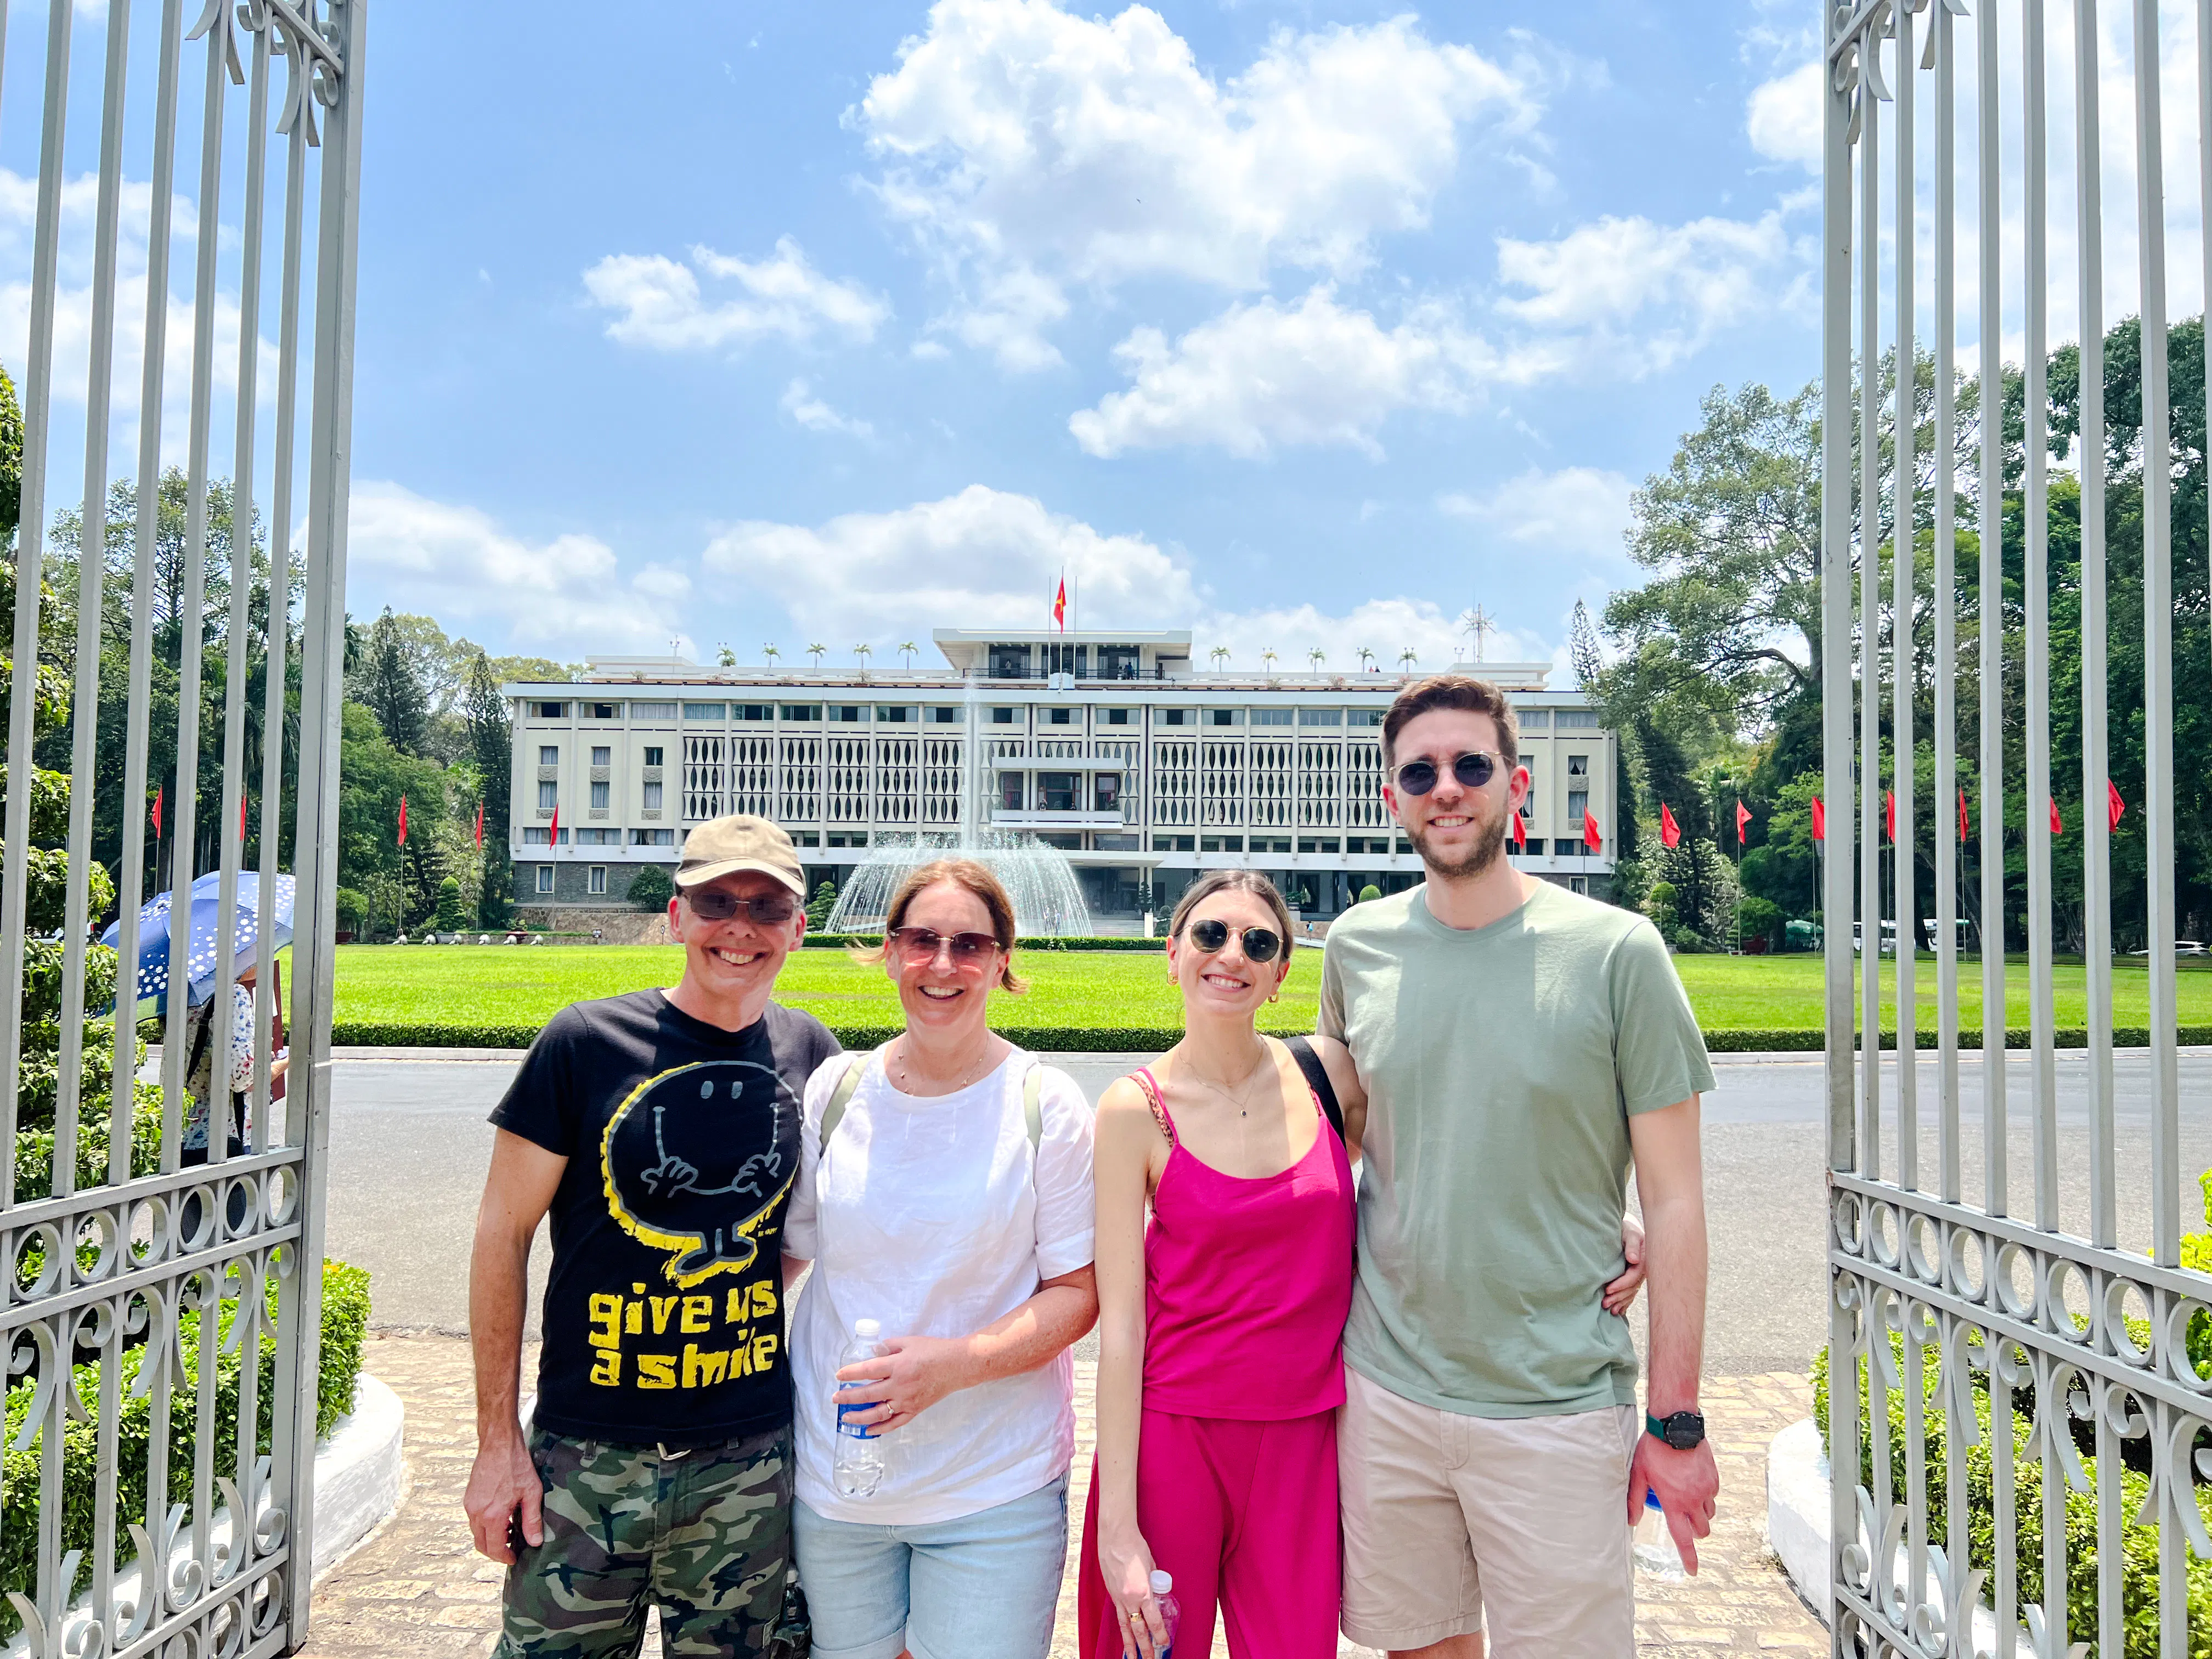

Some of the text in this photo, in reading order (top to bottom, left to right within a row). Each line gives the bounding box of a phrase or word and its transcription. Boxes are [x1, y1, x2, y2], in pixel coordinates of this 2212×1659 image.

[589, 1280, 777, 1350] give us
[590, 1327, 777, 1389] a smile
